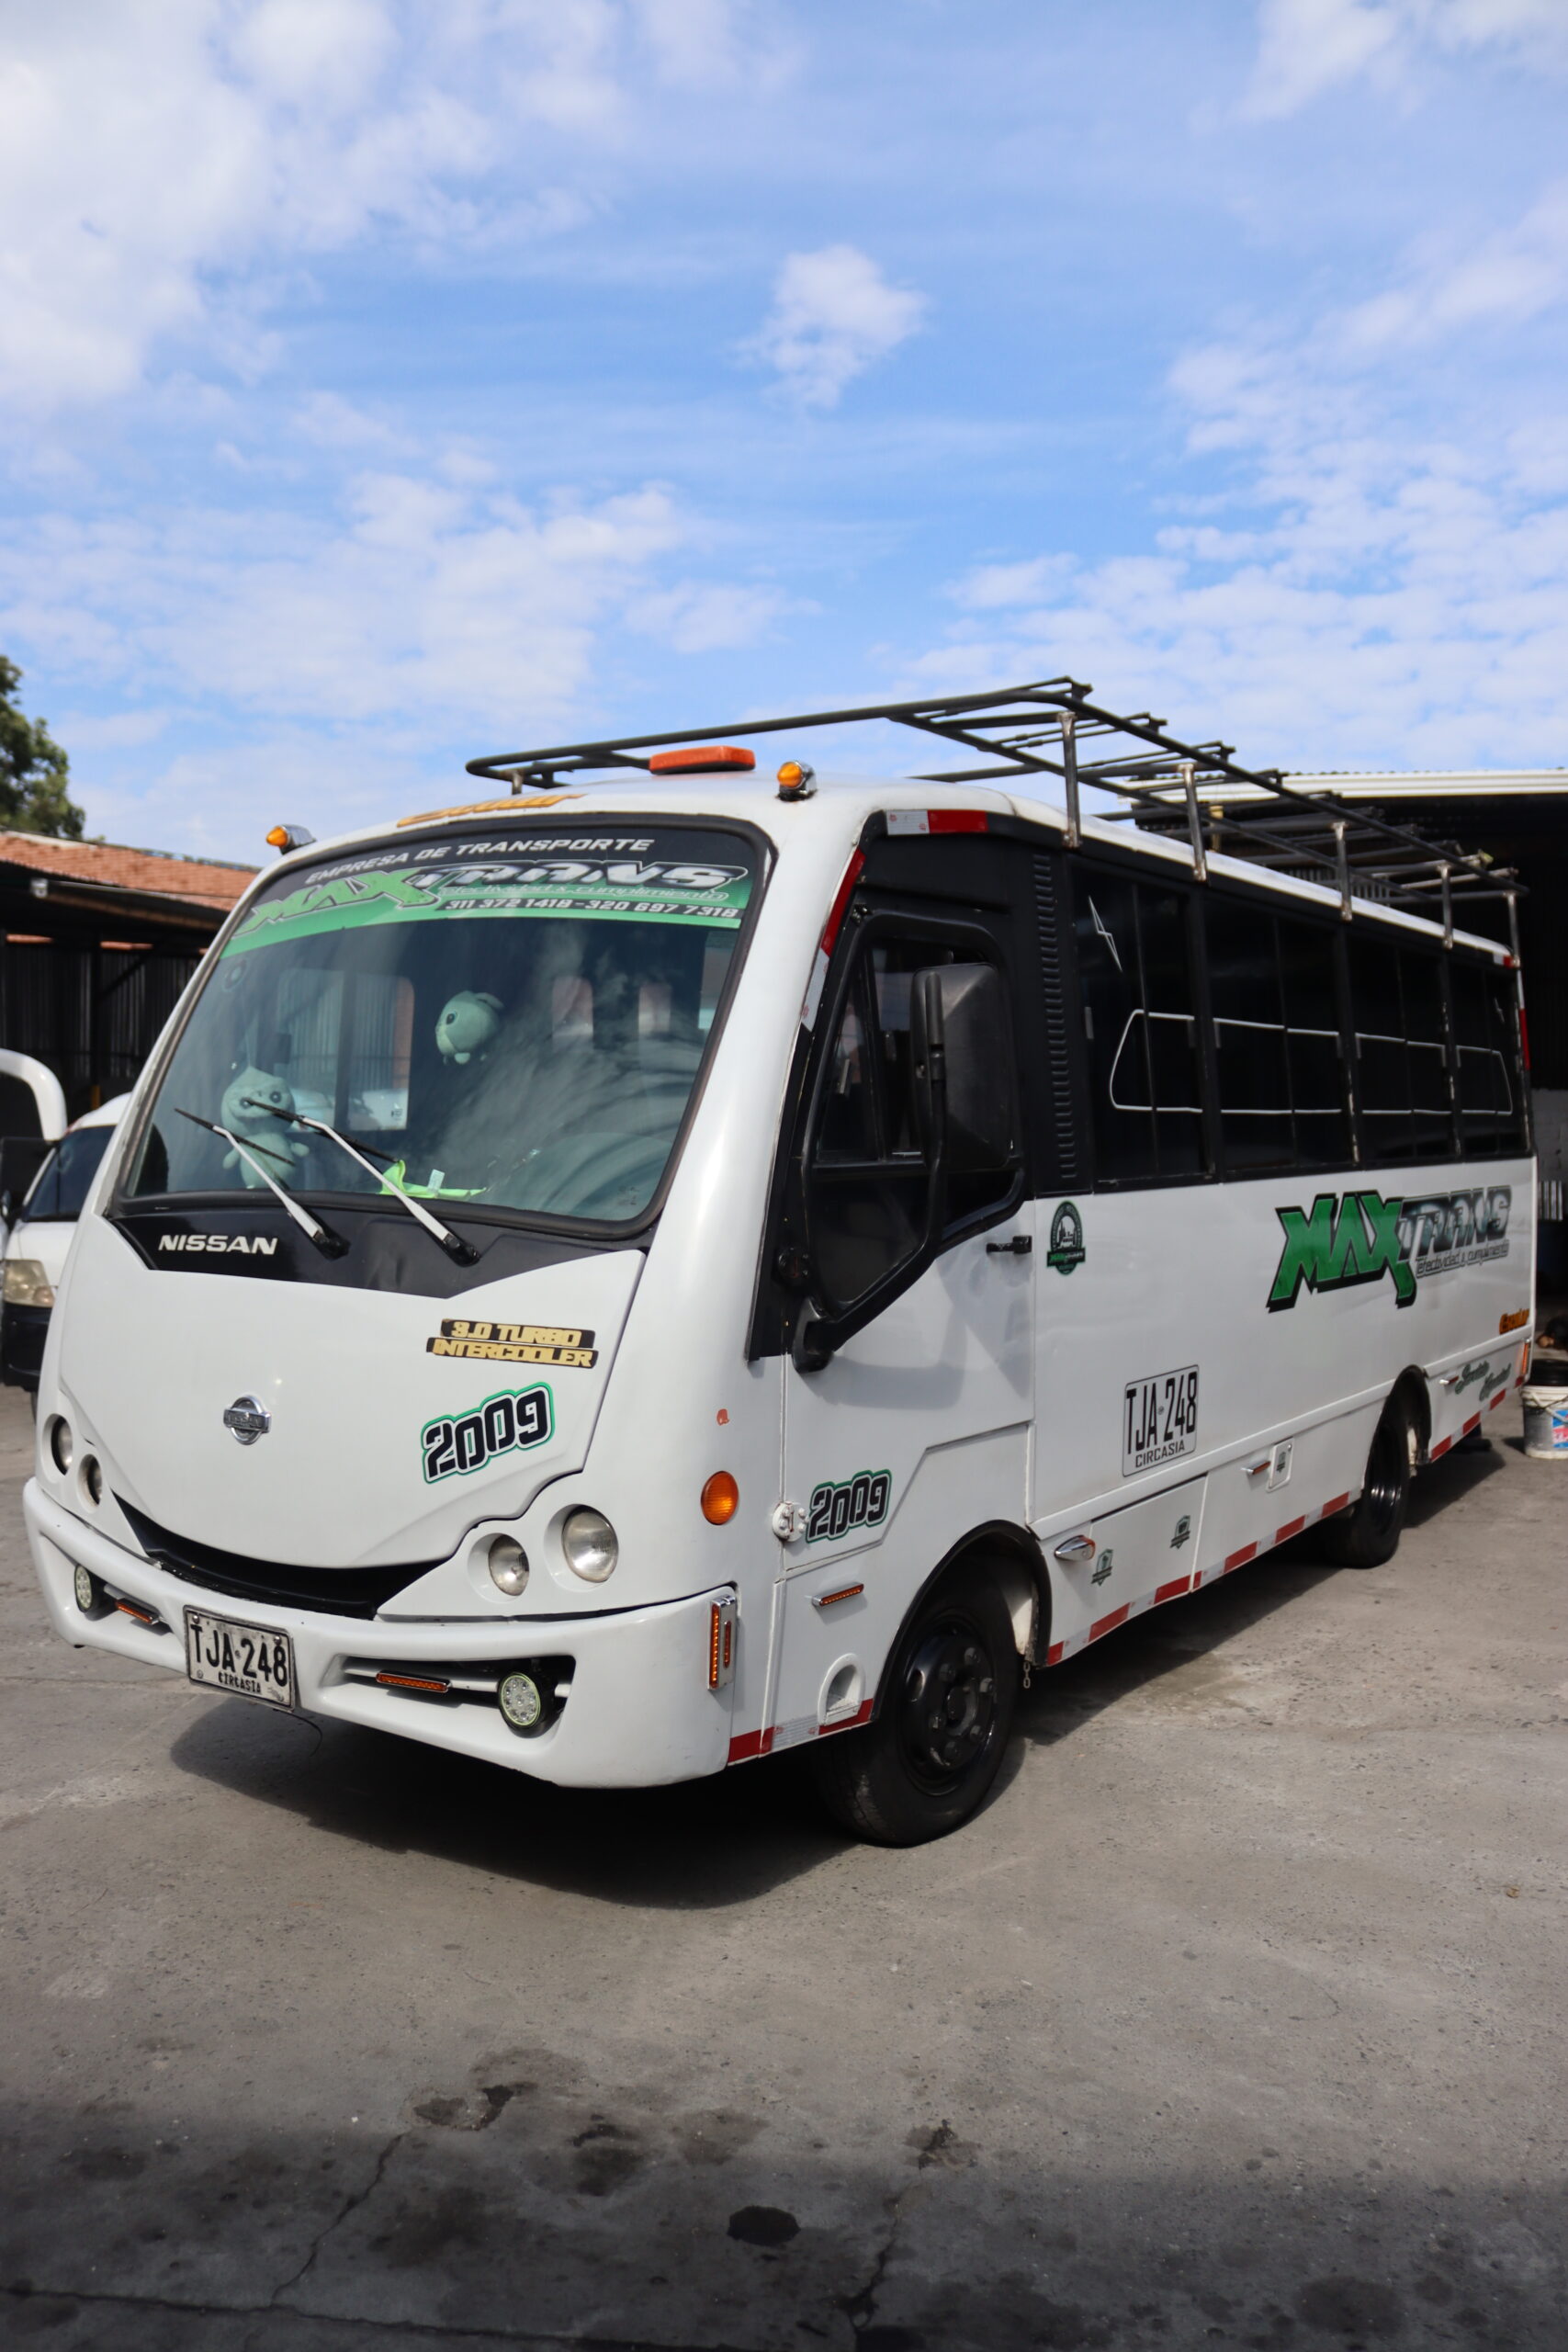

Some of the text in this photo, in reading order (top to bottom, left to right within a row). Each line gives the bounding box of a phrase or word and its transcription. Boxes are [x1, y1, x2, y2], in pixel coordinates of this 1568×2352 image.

[305, 838, 654, 885] EMPRESA DE TRANSPORTE
[446, 899, 476, 910] 311
[479, 899, 522, 909] 372
[634, 902, 679, 913] 697
[158, 1235, 277, 1255] NISSAN
[451, 1321, 582, 1347] 3.0 TURBO
[433, 1338, 593, 1367] INTERCOOLER
[424, 1388, 549, 1480] 2009
[1135, 1440, 1185, 1468] CIRCASIA
[808, 1475, 888, 1538] 2009
[218, 1671, 261, 1693] CIRCASIA
